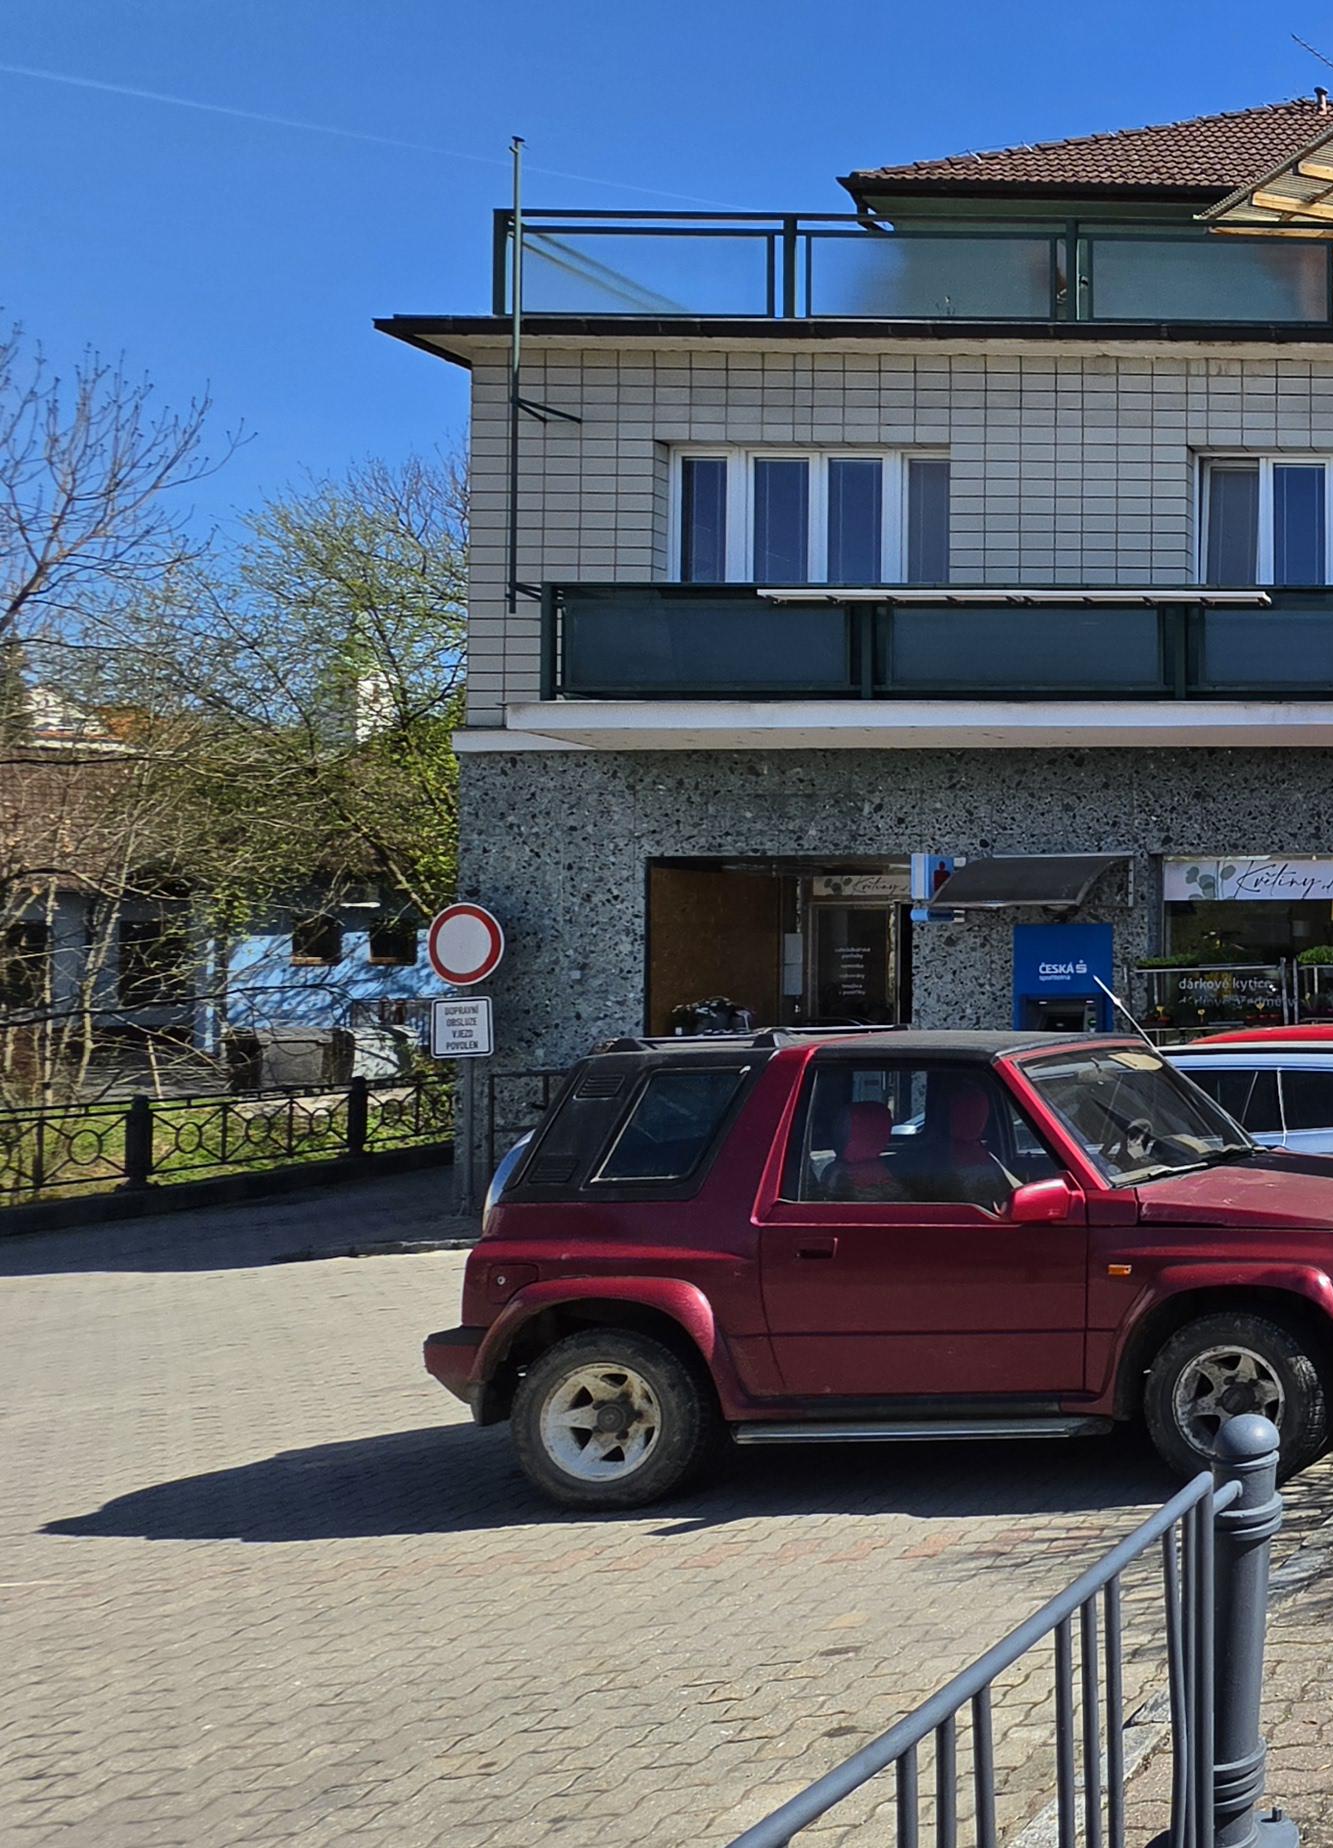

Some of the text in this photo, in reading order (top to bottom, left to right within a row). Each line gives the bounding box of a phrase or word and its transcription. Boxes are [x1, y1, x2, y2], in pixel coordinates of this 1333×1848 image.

[1234, 860, 1321, 899] Květiny
[1039, 961, 1074, 974] ČESKÁ
[1178, 977, 1229, 990] dárkové
[444, 1004, 479, 1016] DOPRAVNÍ
[452, 1029, 474, 1038] VJEZD
[446, 1041, 479, 1050] POVOLEN
